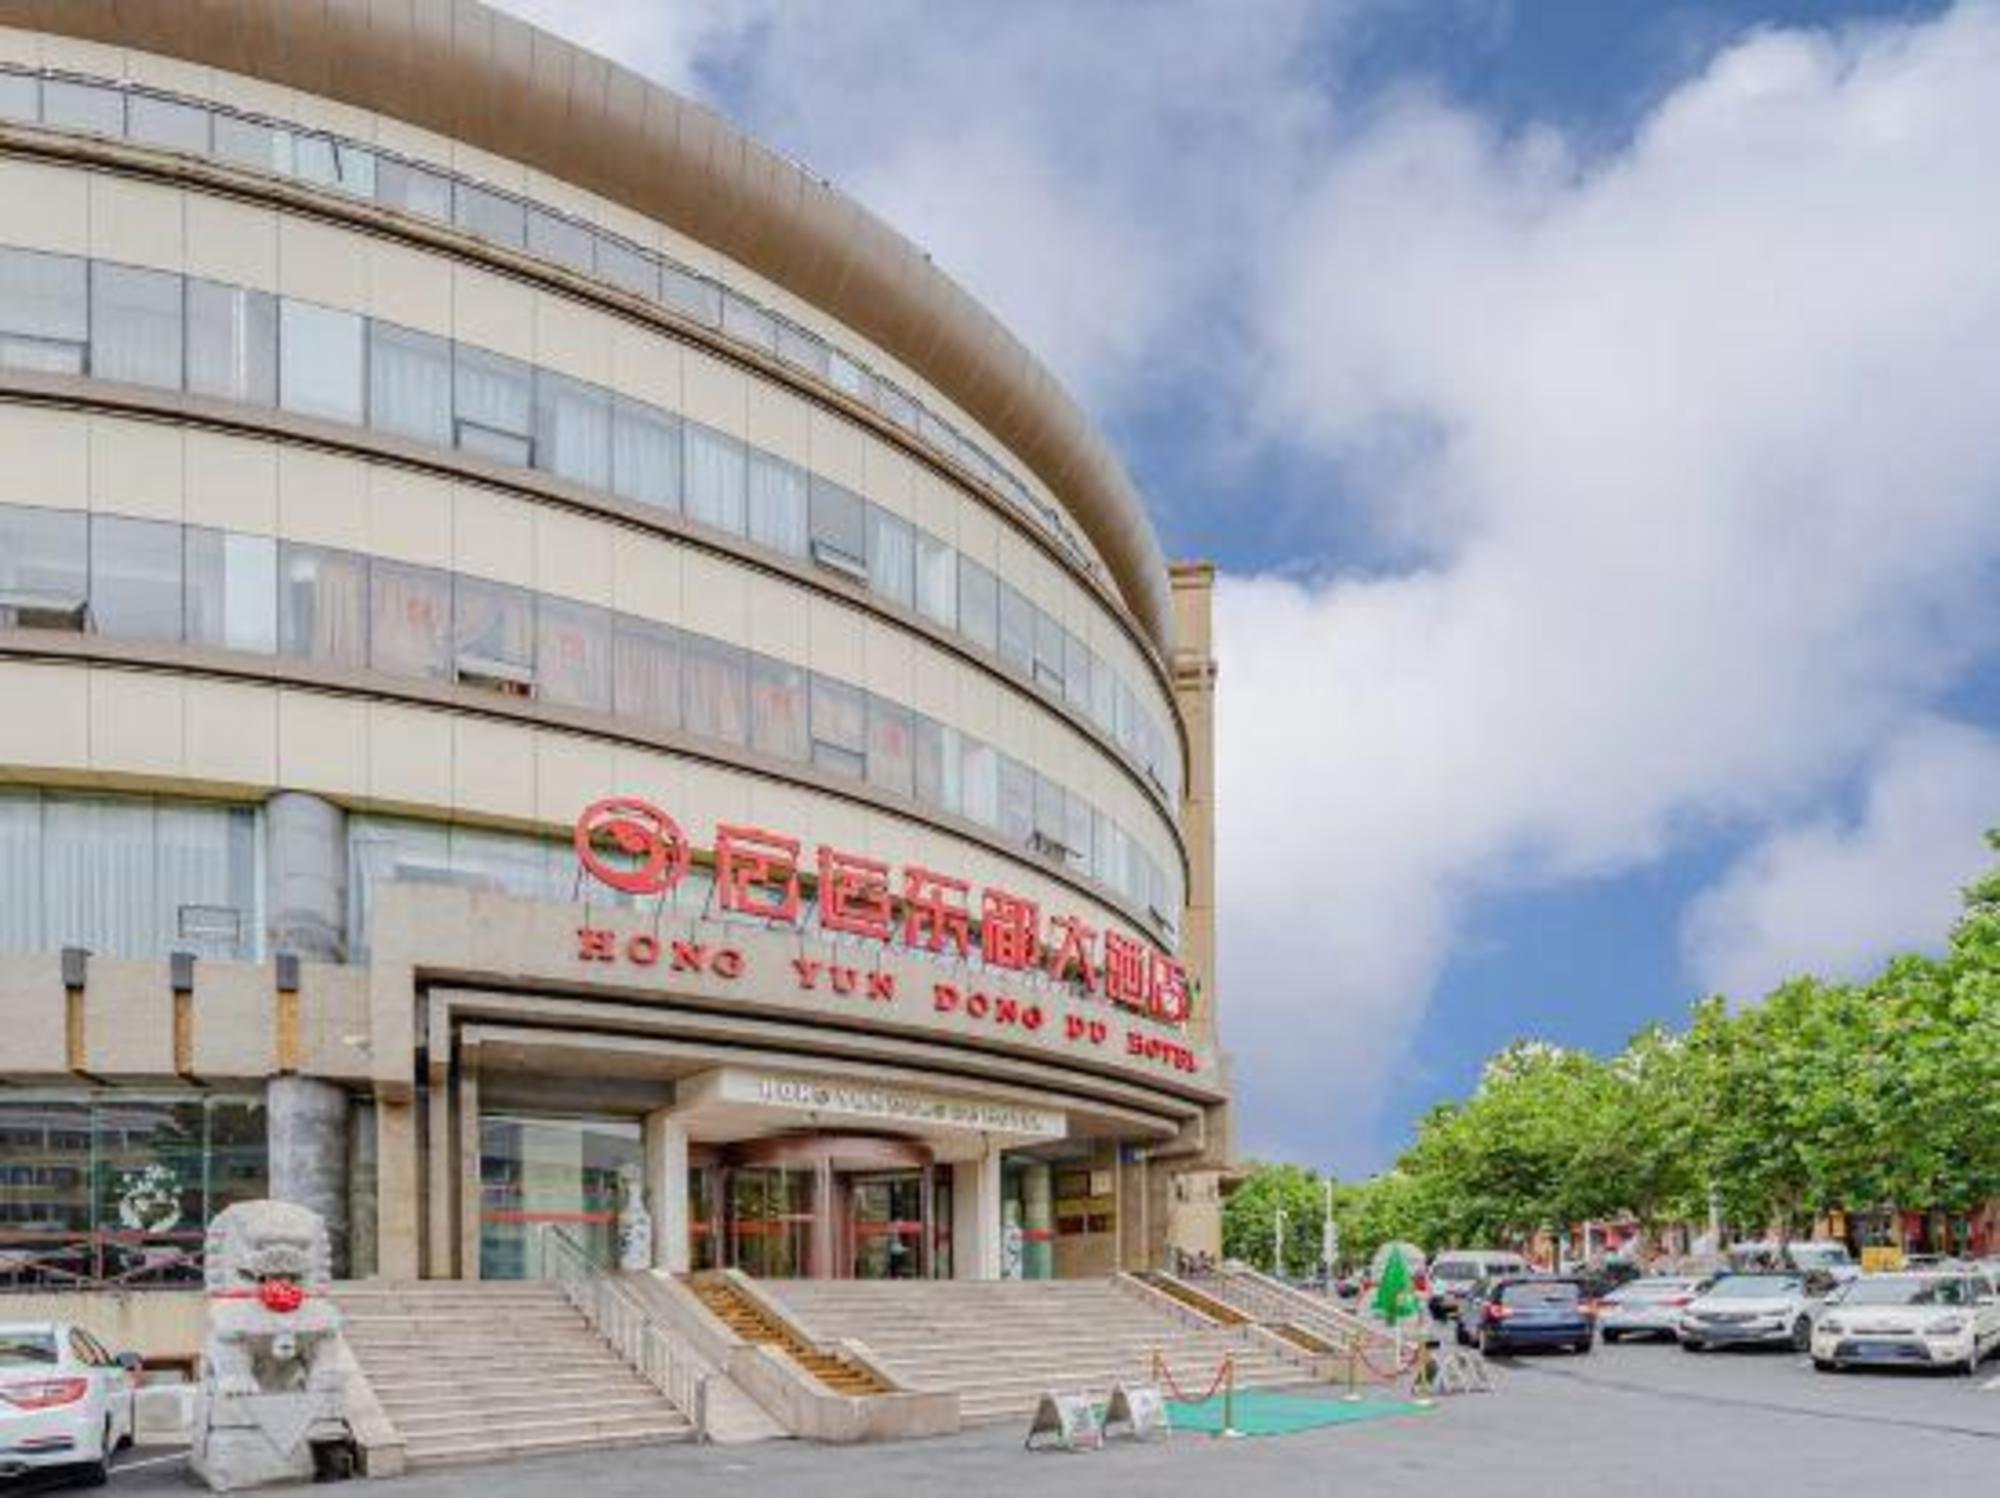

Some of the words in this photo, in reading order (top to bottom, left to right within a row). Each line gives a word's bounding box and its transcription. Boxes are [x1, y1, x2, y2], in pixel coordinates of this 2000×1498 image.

[577, 928, 745, 979] HONG
[792, 957, 894, 1001] YUN
[933, 983, 1043, 1030] DONG
[1065, 1013, 1107, 1044] DU
[1126, 1031, 1198, 1073] HOTEL
